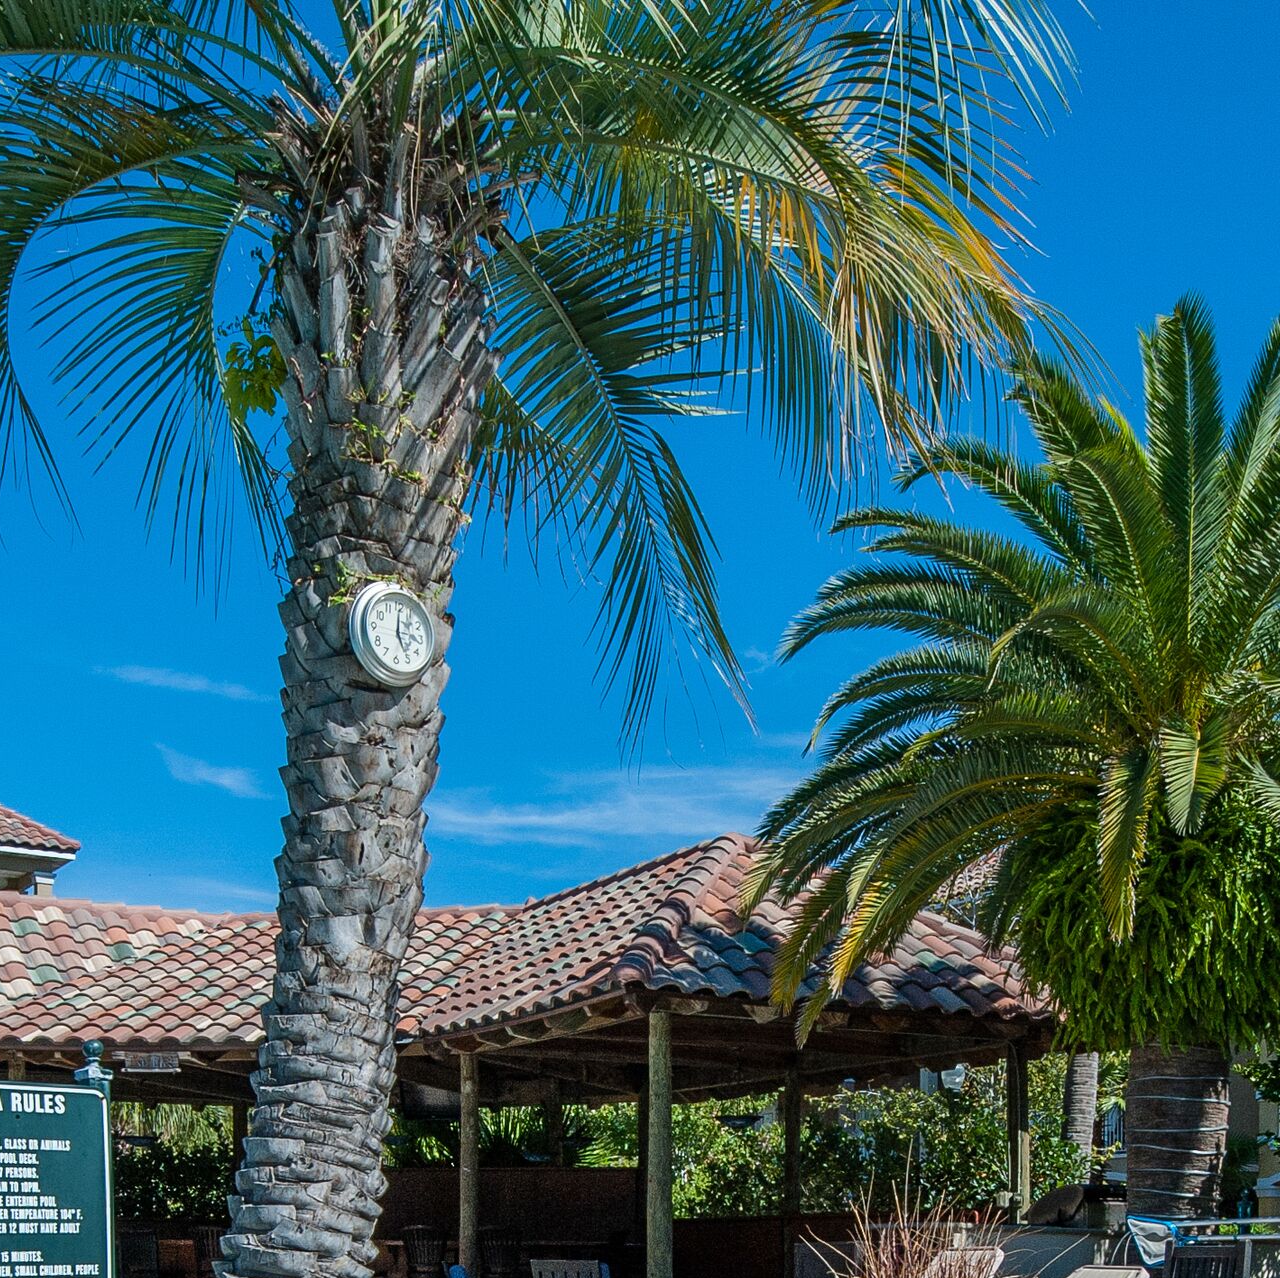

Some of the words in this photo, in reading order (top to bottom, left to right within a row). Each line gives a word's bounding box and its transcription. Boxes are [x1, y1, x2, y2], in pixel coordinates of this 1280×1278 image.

[385, 603, 391, 613] 11
[395, 601, 403, 613] 12
[377, 610, 384, 621] 10
[371, 621, 377, 631] 9
[415, 621, 421, 631] 2
[375, 635, 381, 647] 8
[418, 635, 423, 645] 3
[383, 646, 389, 656] 7
[413, 648, 419, 656] 4
[393, 656, 399, 664] 6
[405, 654, 410, 664] 5
[11, 1092, 65, 1114] RULES
[5, 1138, 26, 1150] GLASS
[29, 1140, 38, 1150] OR
[40, 1140, 70, 1151] ANIMALS
[0, 1153, 17, 1164] POOL
[19, 1153, 39, 1164] DECK.
[5, 1167, 39, 1178] PERSONS.
[10, 1182, 18, 1192] TO
[5, 1196, 38, 1207] ENTERING
[40, 1196, 57, 1207] POOL
[10, 1209, 58, 1220] TEMPERATURE
[76, 1209, 83, 1220] F.
[9, 1223, 17, 1234] 12
[19, 1223, 38, 1234] MUST
[40, 1223, 57, 1233] HAVE
[60, 1223, 80, 1233] ADULT
[1, 1251, 9, 1262] 15
[11, 1251, 43, 1262] MINUTES.
[15, 1266, 38, 1276] SMALL
[75, 1264, 99, 1275] PEOPLE
